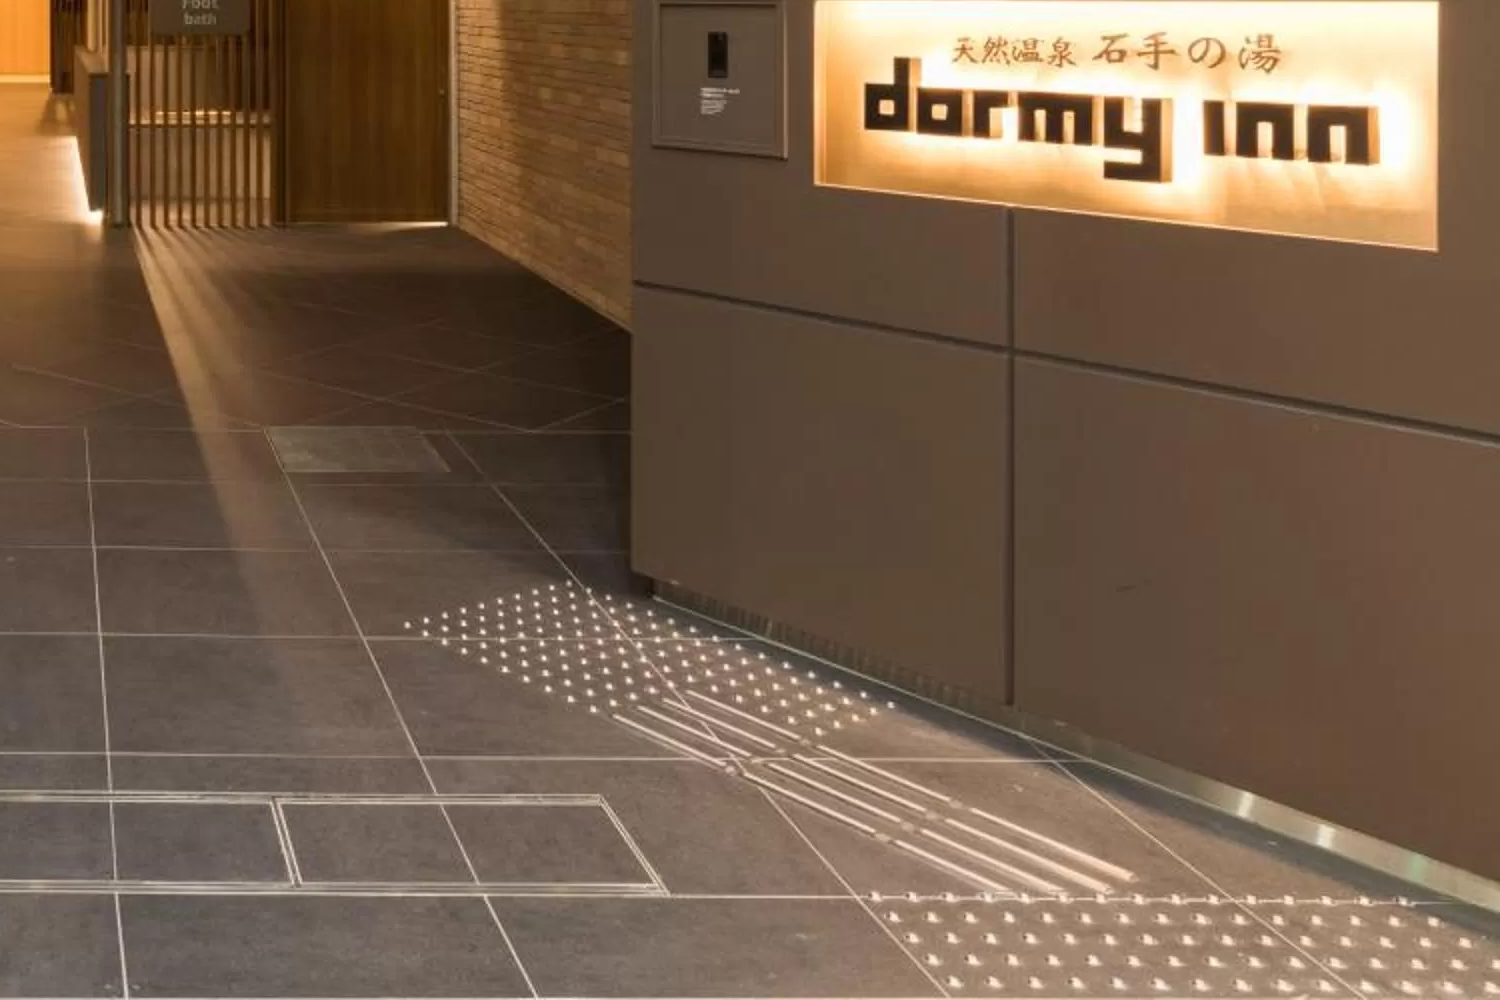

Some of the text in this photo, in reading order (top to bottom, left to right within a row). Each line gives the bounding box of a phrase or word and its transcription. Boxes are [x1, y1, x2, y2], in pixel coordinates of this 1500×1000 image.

[952, 31, 1282, 74] 天然温泉 石手の湯
[864, 57, 1380, 183] dormy inn
